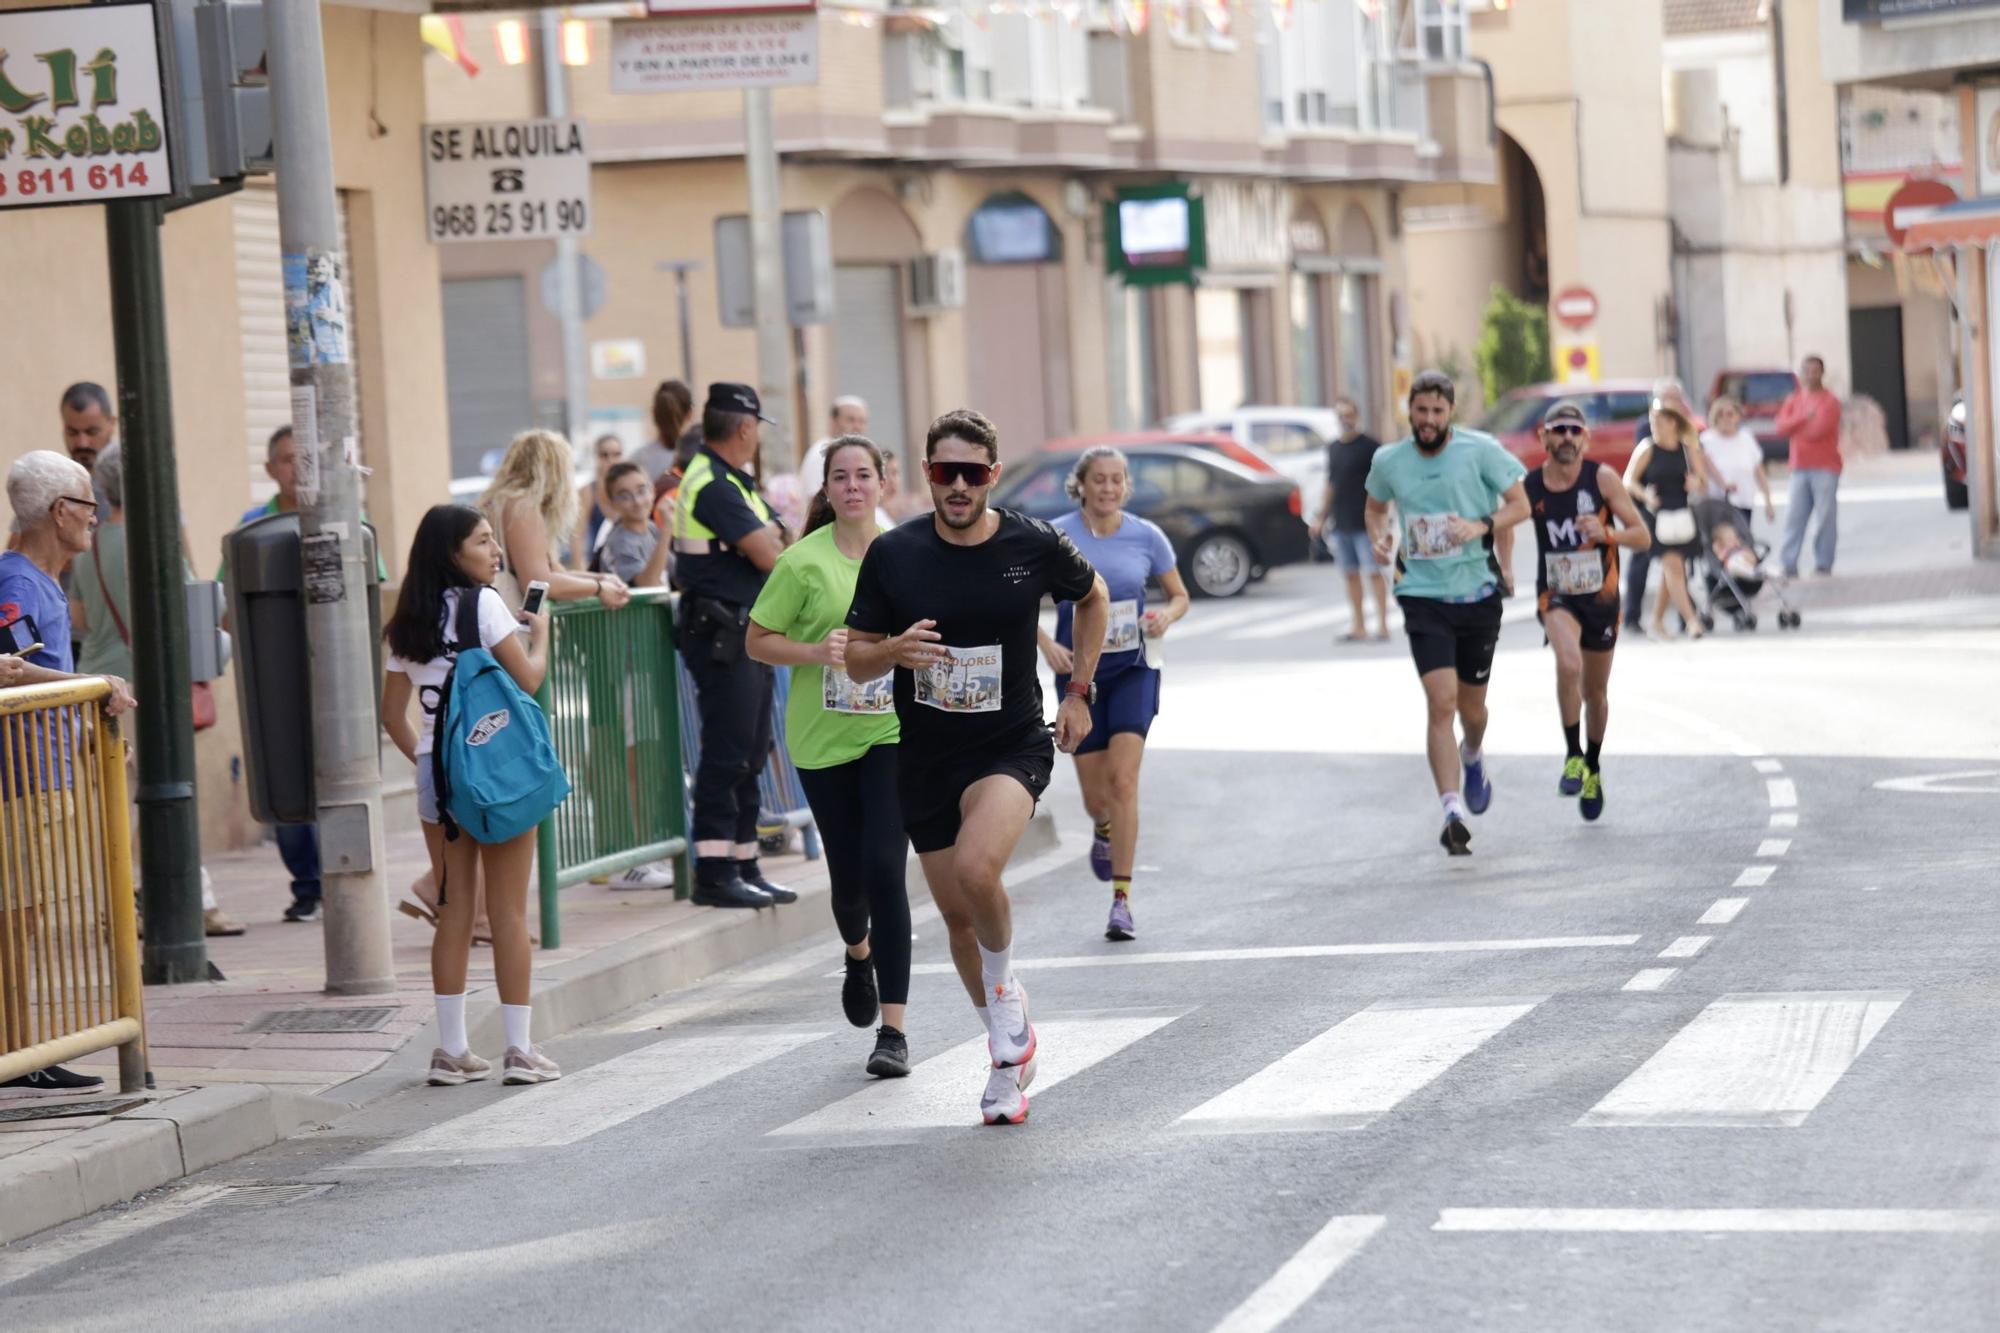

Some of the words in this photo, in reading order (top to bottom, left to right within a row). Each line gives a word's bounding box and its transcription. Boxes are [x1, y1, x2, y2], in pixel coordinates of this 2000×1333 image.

[656, 41, 714, 53] PARTIR
[718, 40, 738, 51] DE
[679, 56, 735, 69] PARTIR
[740, 55, 761, 67] DE
[16, 108, 161, 159] Kebab
[431, 129, 462, 161] SE
[472, 124, 583, 158] ALQUILA
[17, 166, 74, 195] 811
[88, 161, 148, 190] 614
[434, 205, 476, 236] 968
[486, 203, 513, 234] 25
[521, 202, 547, 232] 91
[557, 199, 584, 230] 90
